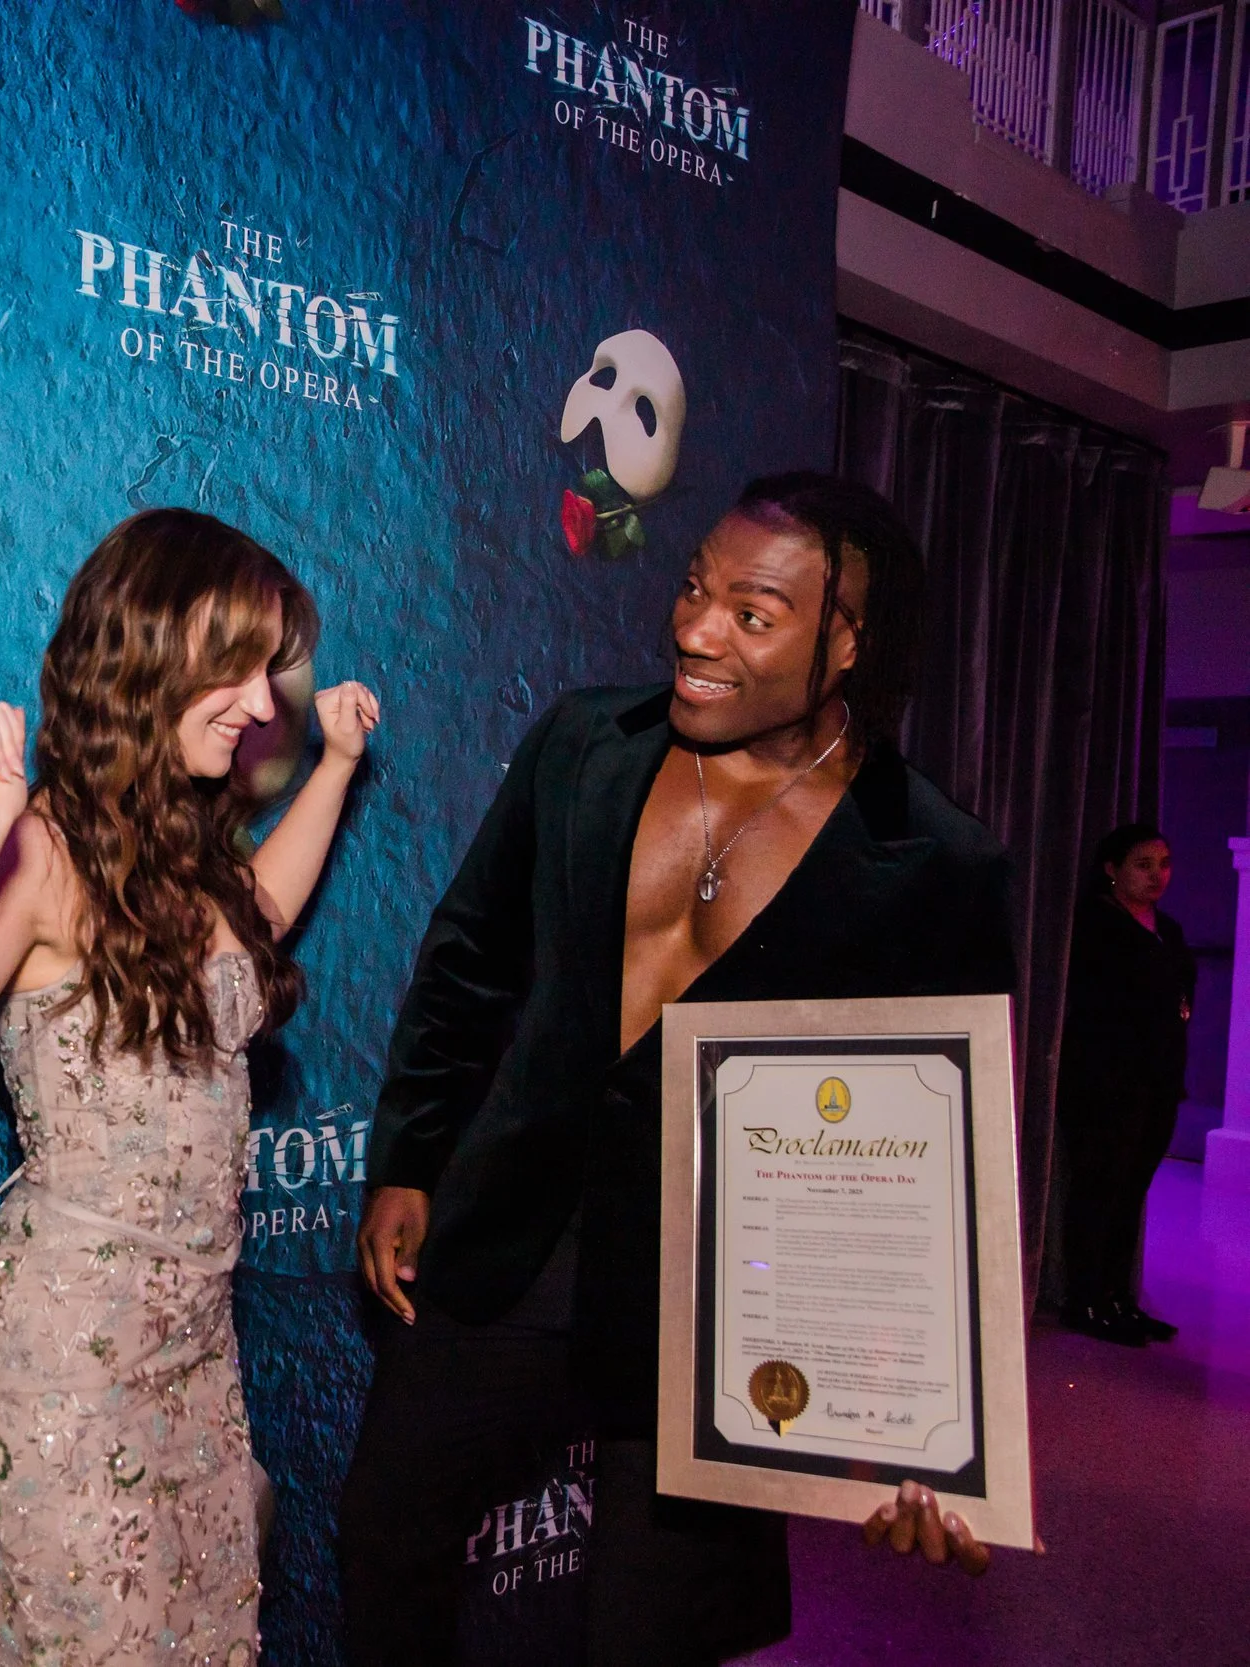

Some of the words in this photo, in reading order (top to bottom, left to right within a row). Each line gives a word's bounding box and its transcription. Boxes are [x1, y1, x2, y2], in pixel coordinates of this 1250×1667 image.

[624, 19, 669, 58] THE
[524, 17, 750, 161] PHANTOM
[554, 101, 585, 130] OF
[596, 115, 640, 153] THE
[651, 138, 722, 186] OPERA
[221, 221, 282, 263] THE
[76, 229, 400, 378] PHANTOM
[121, 328, 164, 361] OF
[180, 341, 244, 382] THE
[260, 363, 362, 410] OPERA
[743, 1126, 928, 1159] Proclamation
[240, 1203, 330, 1238] PERA
[566, 1440, 595, 1468] TH
[492, 1566, 524, 1596] OF
[534, 1548, 580, 1583] THE
